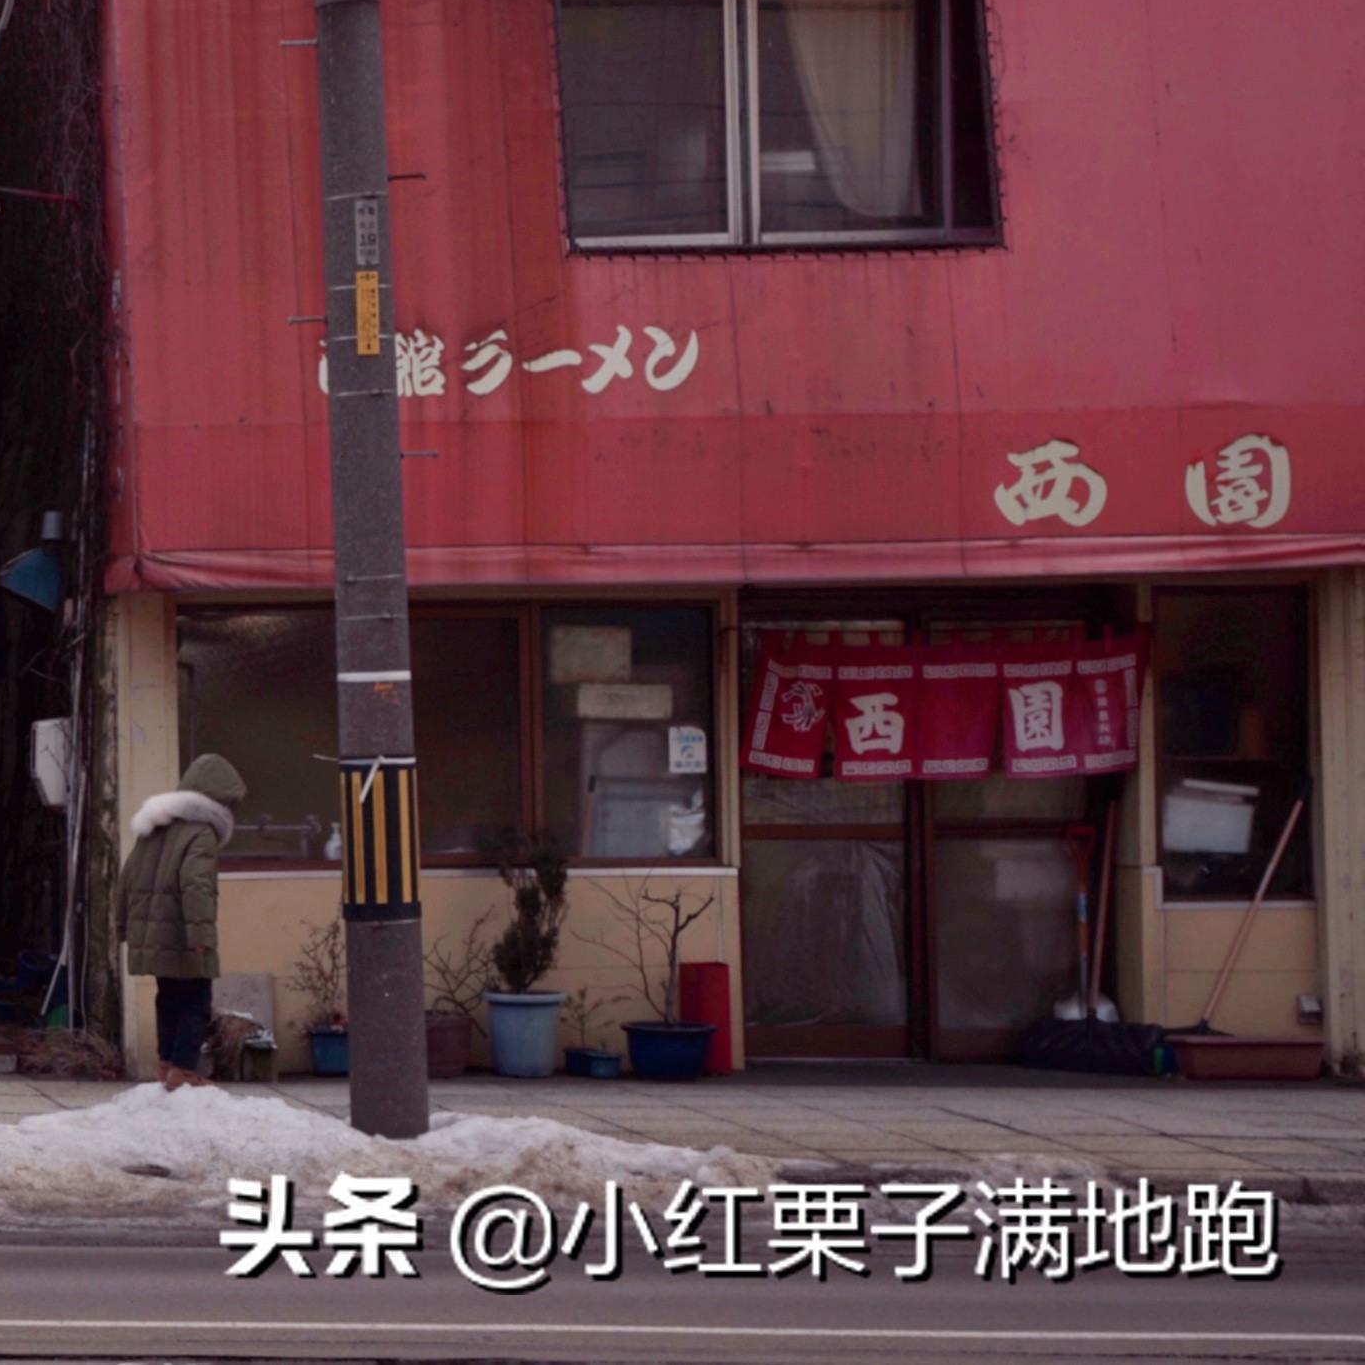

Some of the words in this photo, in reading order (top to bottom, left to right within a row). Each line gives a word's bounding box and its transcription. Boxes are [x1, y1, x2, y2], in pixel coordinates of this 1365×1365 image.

[319, 325, 699, 396] 館ラーメン
[844, 680, 1064, 755] 西園
